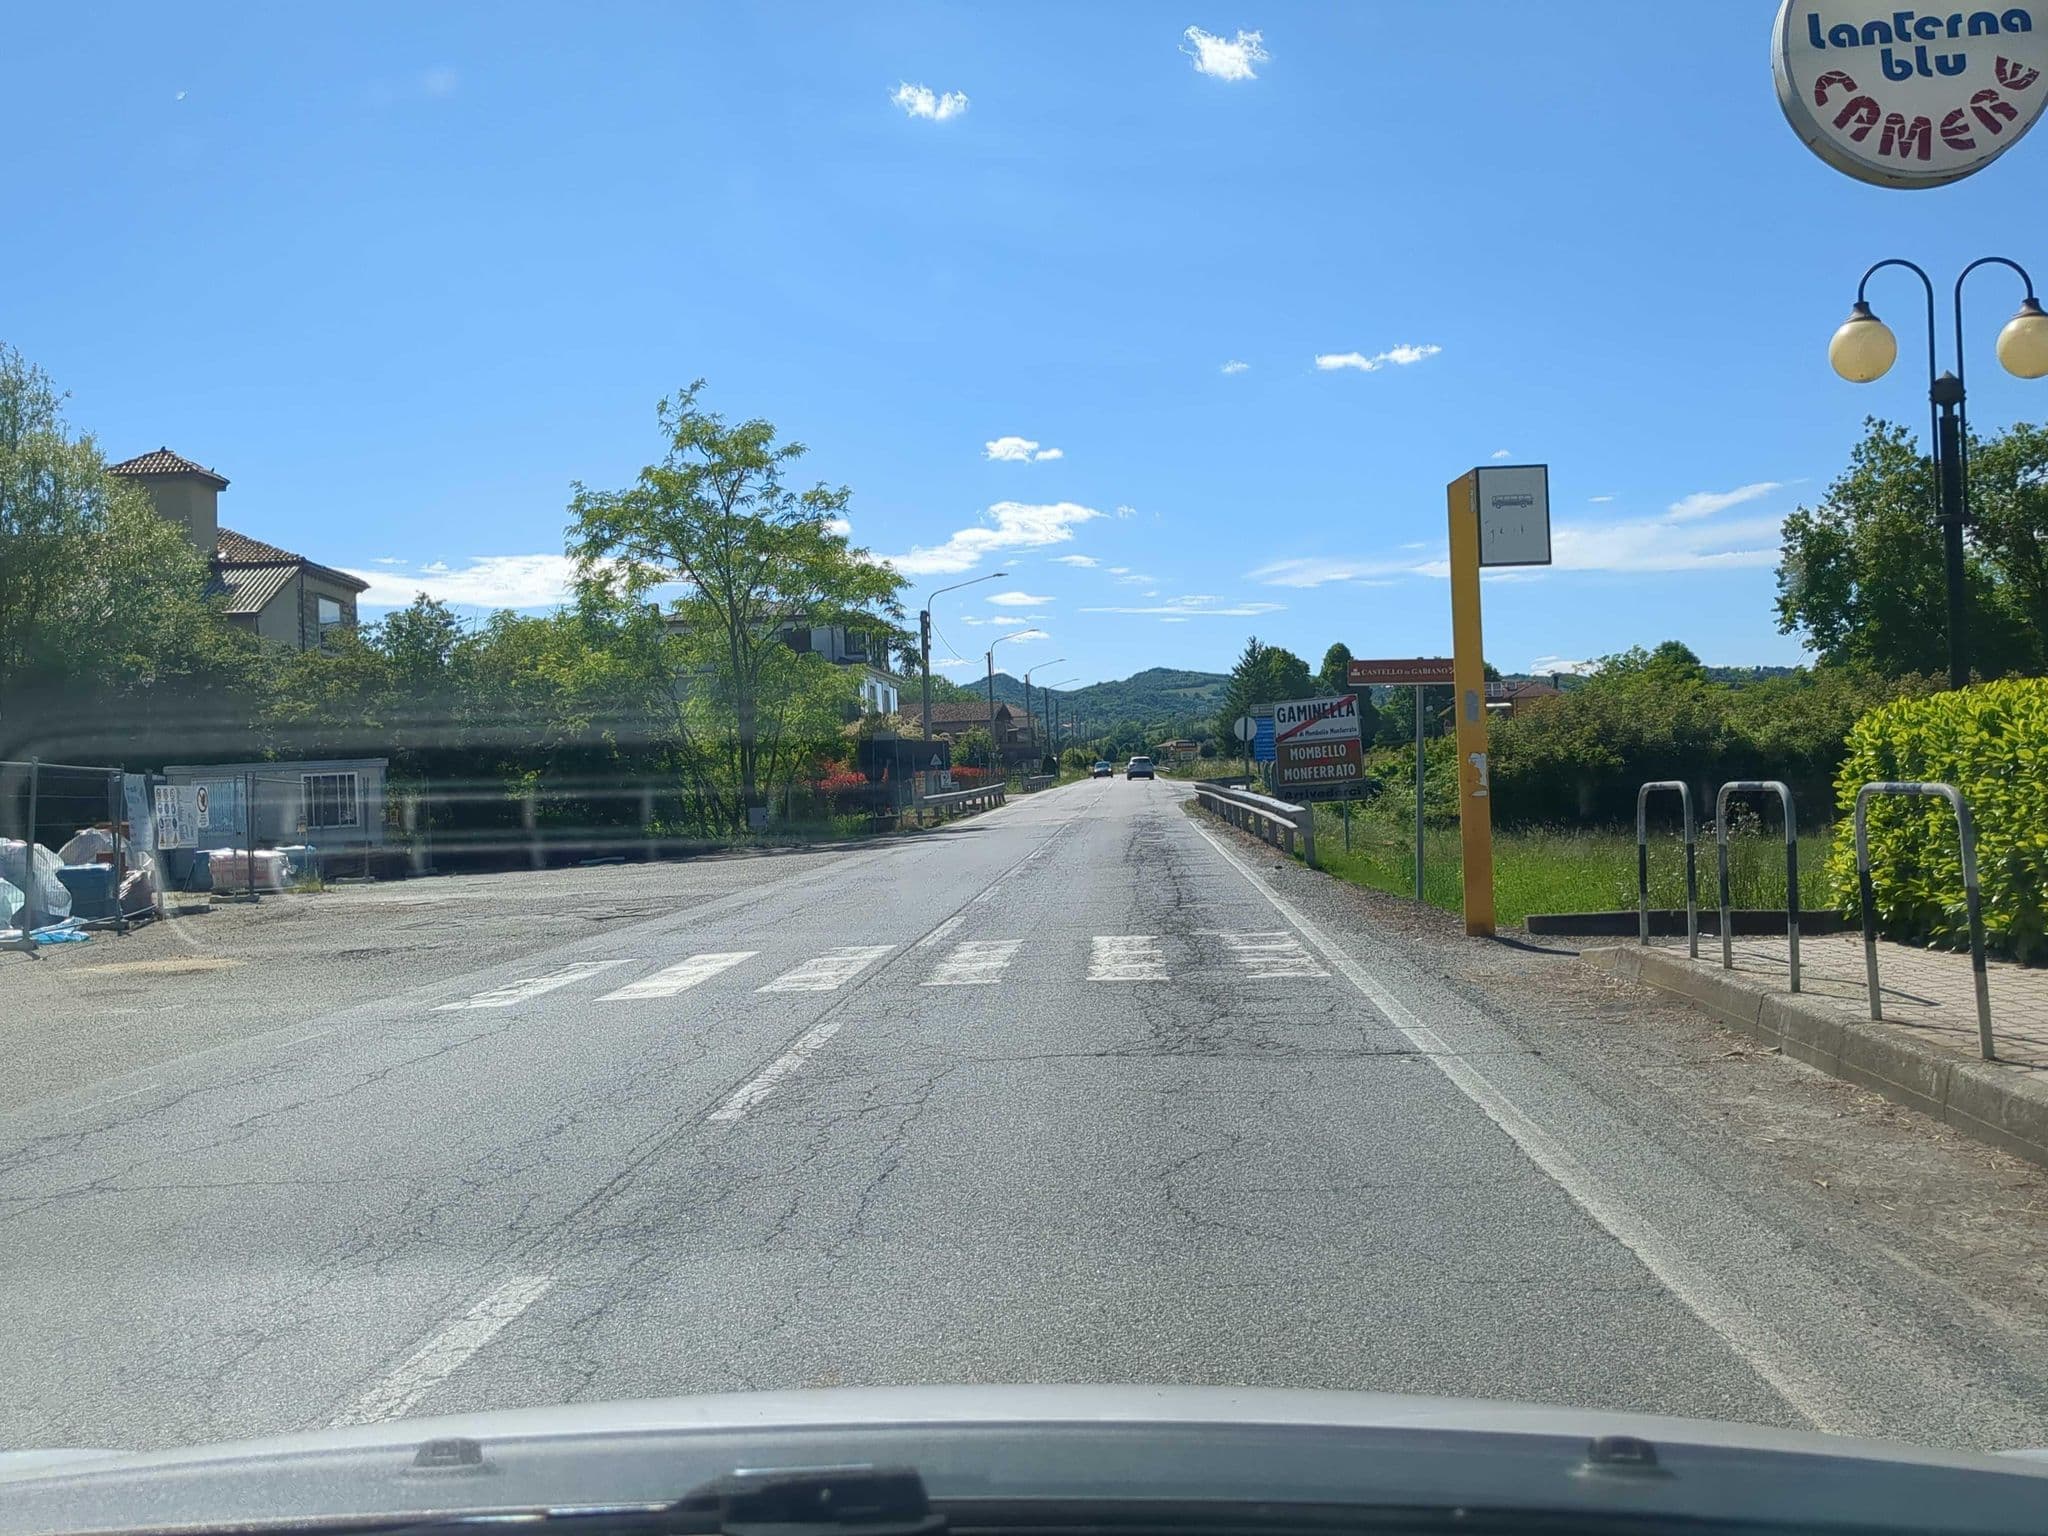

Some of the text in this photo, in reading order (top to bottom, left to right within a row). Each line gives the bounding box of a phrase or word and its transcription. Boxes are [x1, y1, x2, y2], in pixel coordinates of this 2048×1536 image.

[1807, 8, 2033, 50] lanterna
[1880, 45, 1967, 81] blu
[1814, 54, 2041, 161] CAMERE
[1277, 702, 1356, 723] GAMINELLA
[1290, 743, 1347, 760] MOMBELLO
[1284, 763, 1356, 780] MONFERRATO
